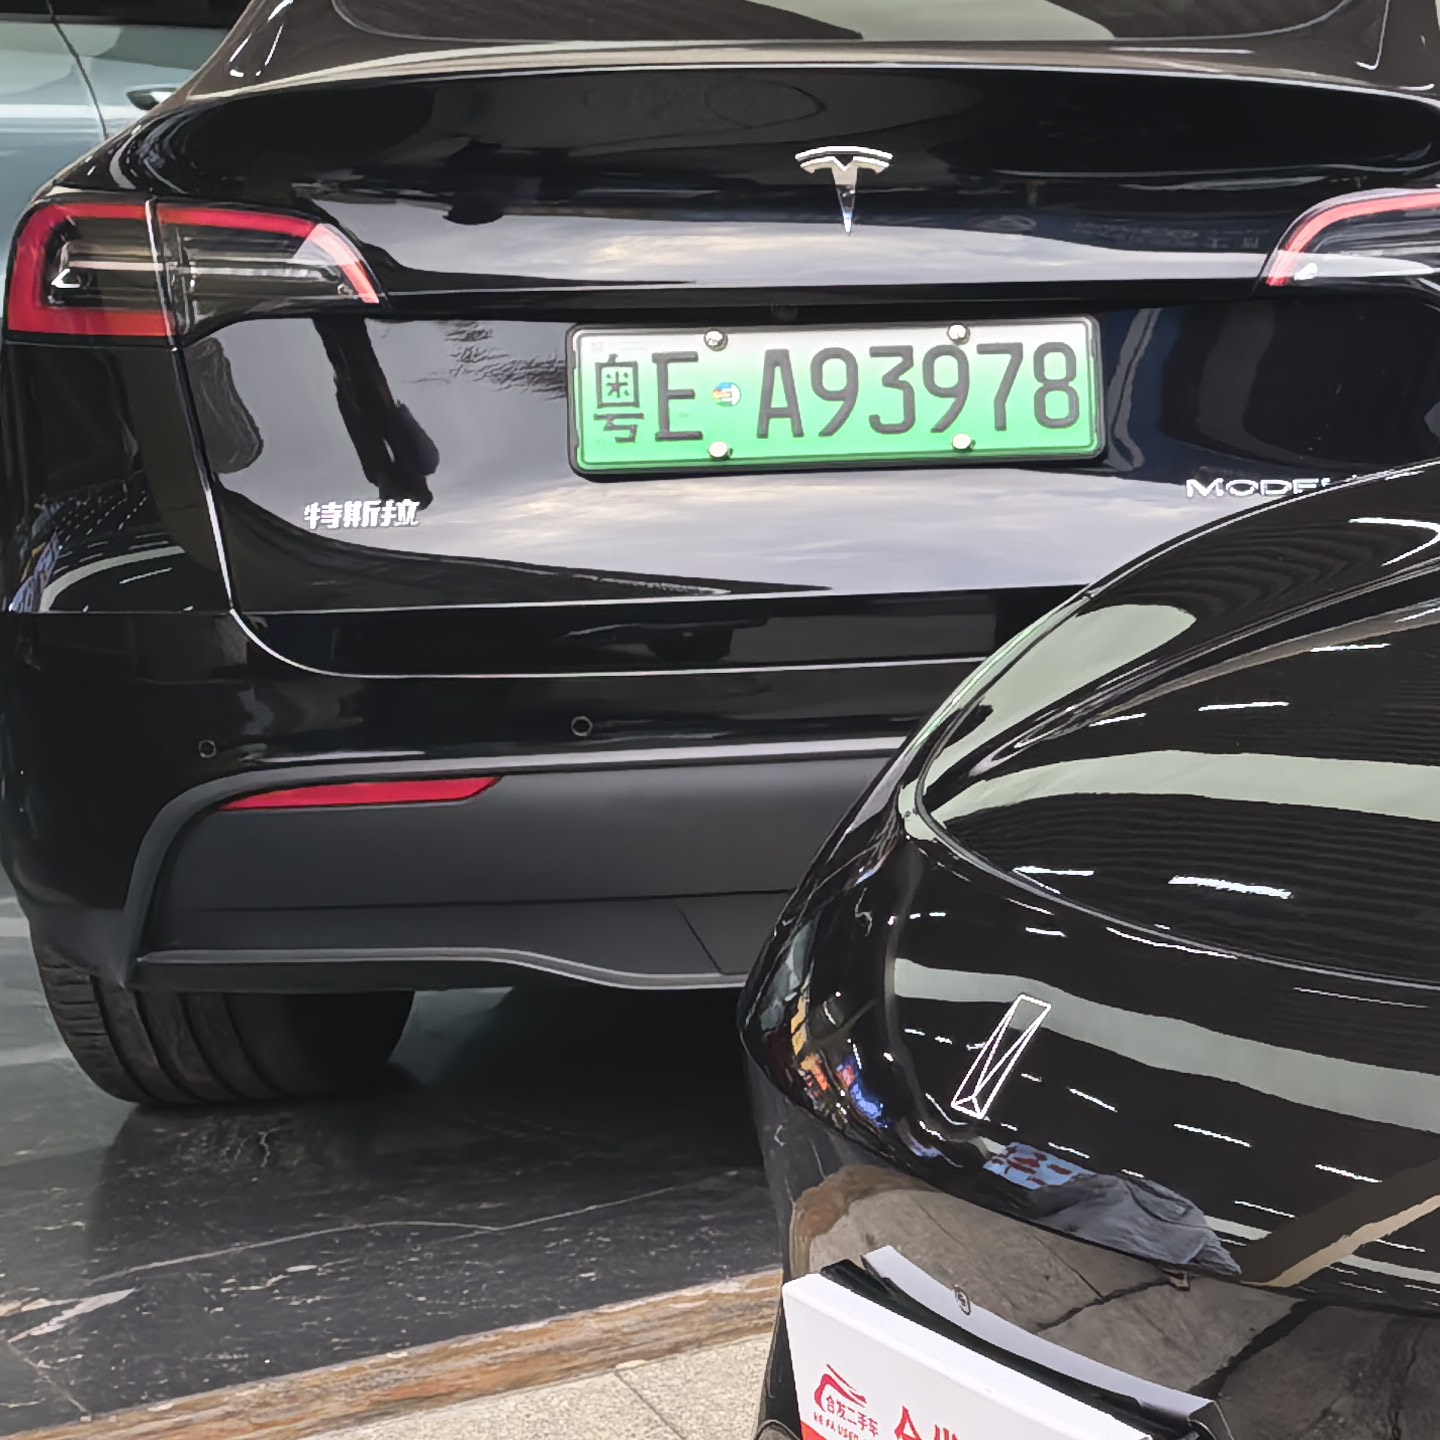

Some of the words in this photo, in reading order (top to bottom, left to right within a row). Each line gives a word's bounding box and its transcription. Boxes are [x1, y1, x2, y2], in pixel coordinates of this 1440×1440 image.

[593, 350, 704, 444] 粤E
[756, 341, 1081, 439] A93978
[1185, 477, 1331, 498] MODE
[304, 498, 420, 530] 特斯拉
